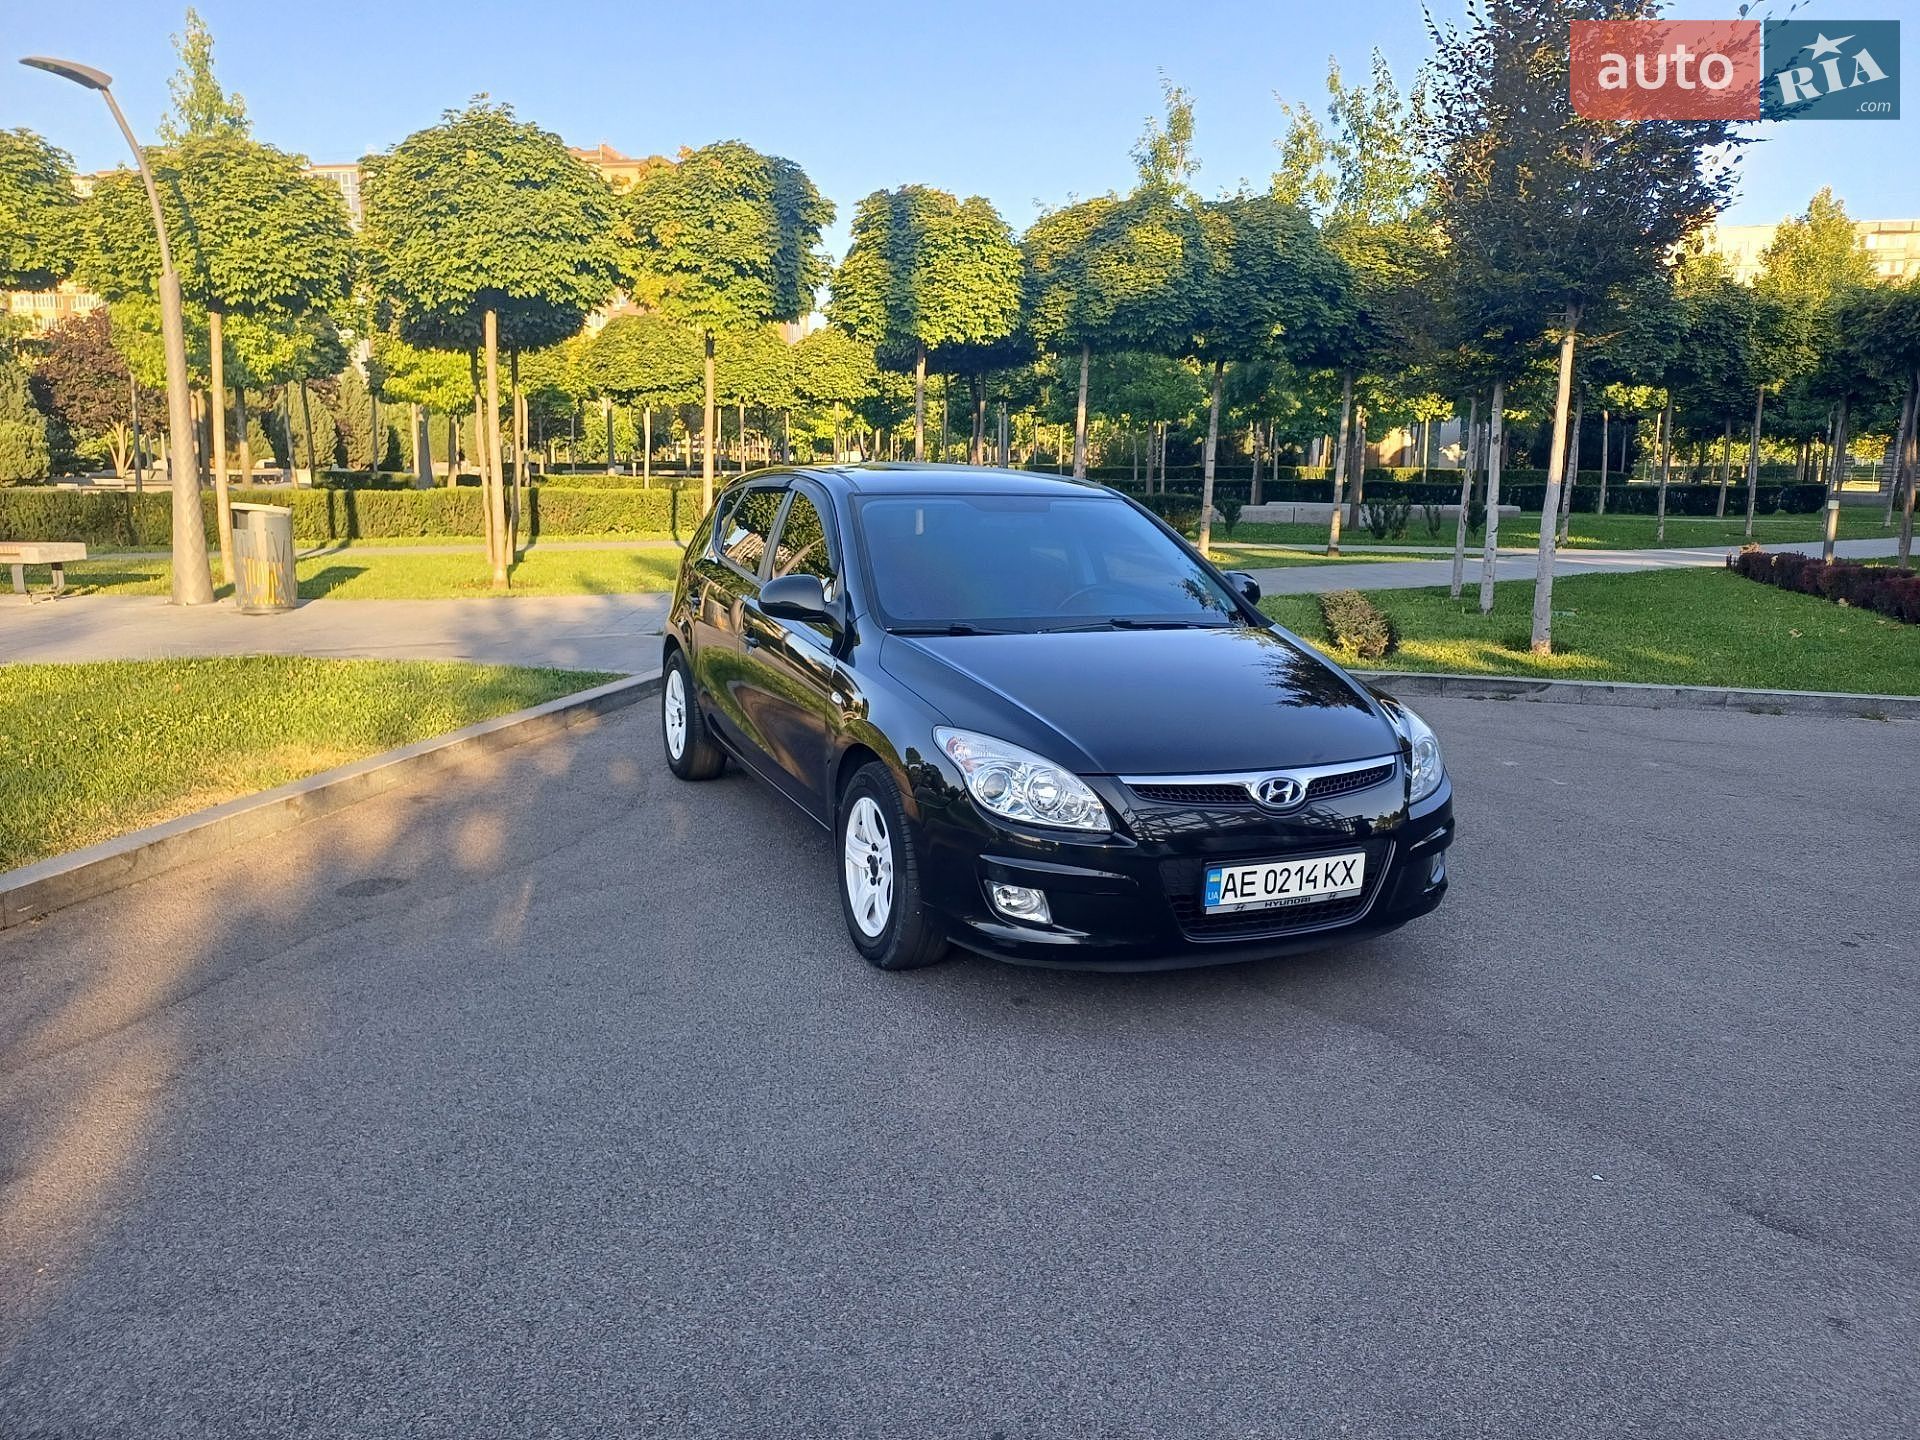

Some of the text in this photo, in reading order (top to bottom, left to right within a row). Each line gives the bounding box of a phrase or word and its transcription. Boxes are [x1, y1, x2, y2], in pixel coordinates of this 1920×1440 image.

[1221, 858, 1357, 900] AE 0214 KX
[1207, 891, 1219, 900] UA
[1264, 897, 1311, 908] HYUNDAI
